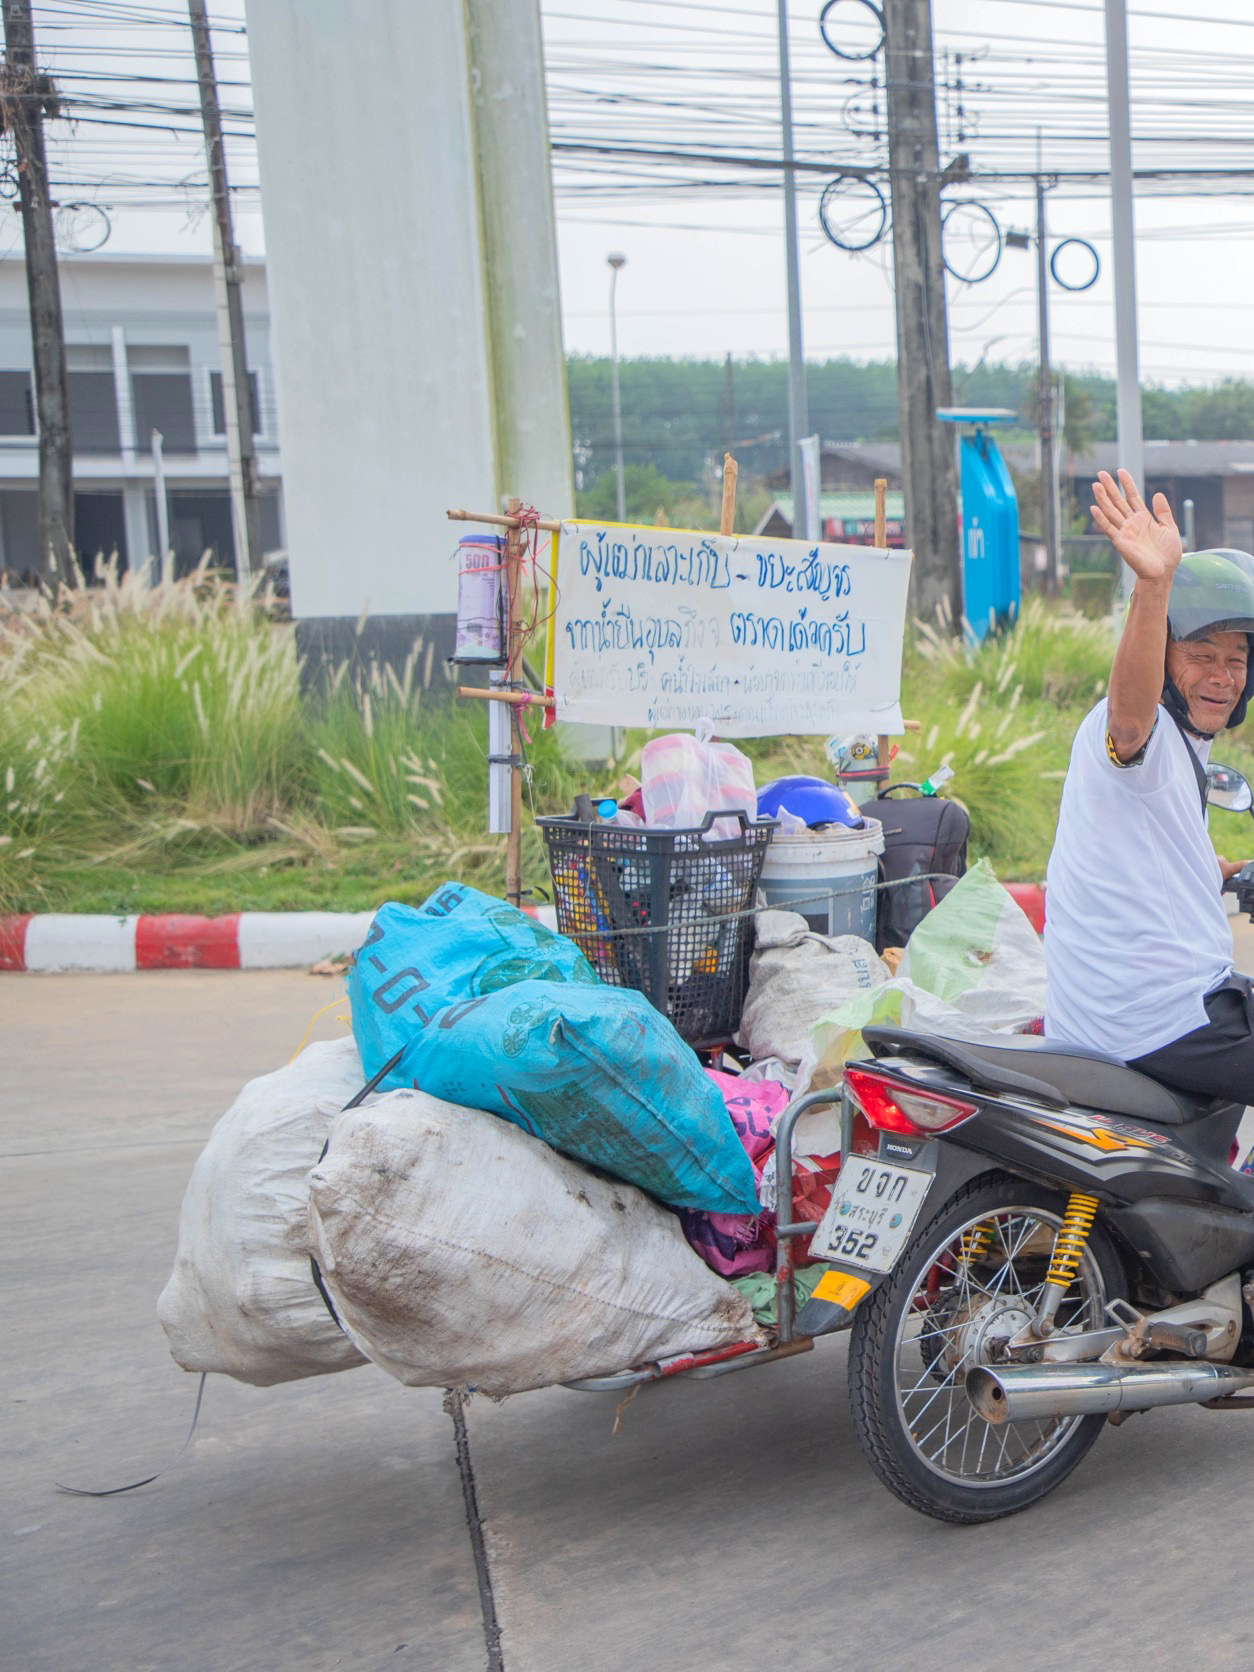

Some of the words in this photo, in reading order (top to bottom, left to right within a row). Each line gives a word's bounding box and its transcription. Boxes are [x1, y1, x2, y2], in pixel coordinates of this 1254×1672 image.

[886, 1143, 913, 1155] HONDA
[848, 1204, 889, 1229] สระบุรี
[827, 1224, 879, 1261] 352
